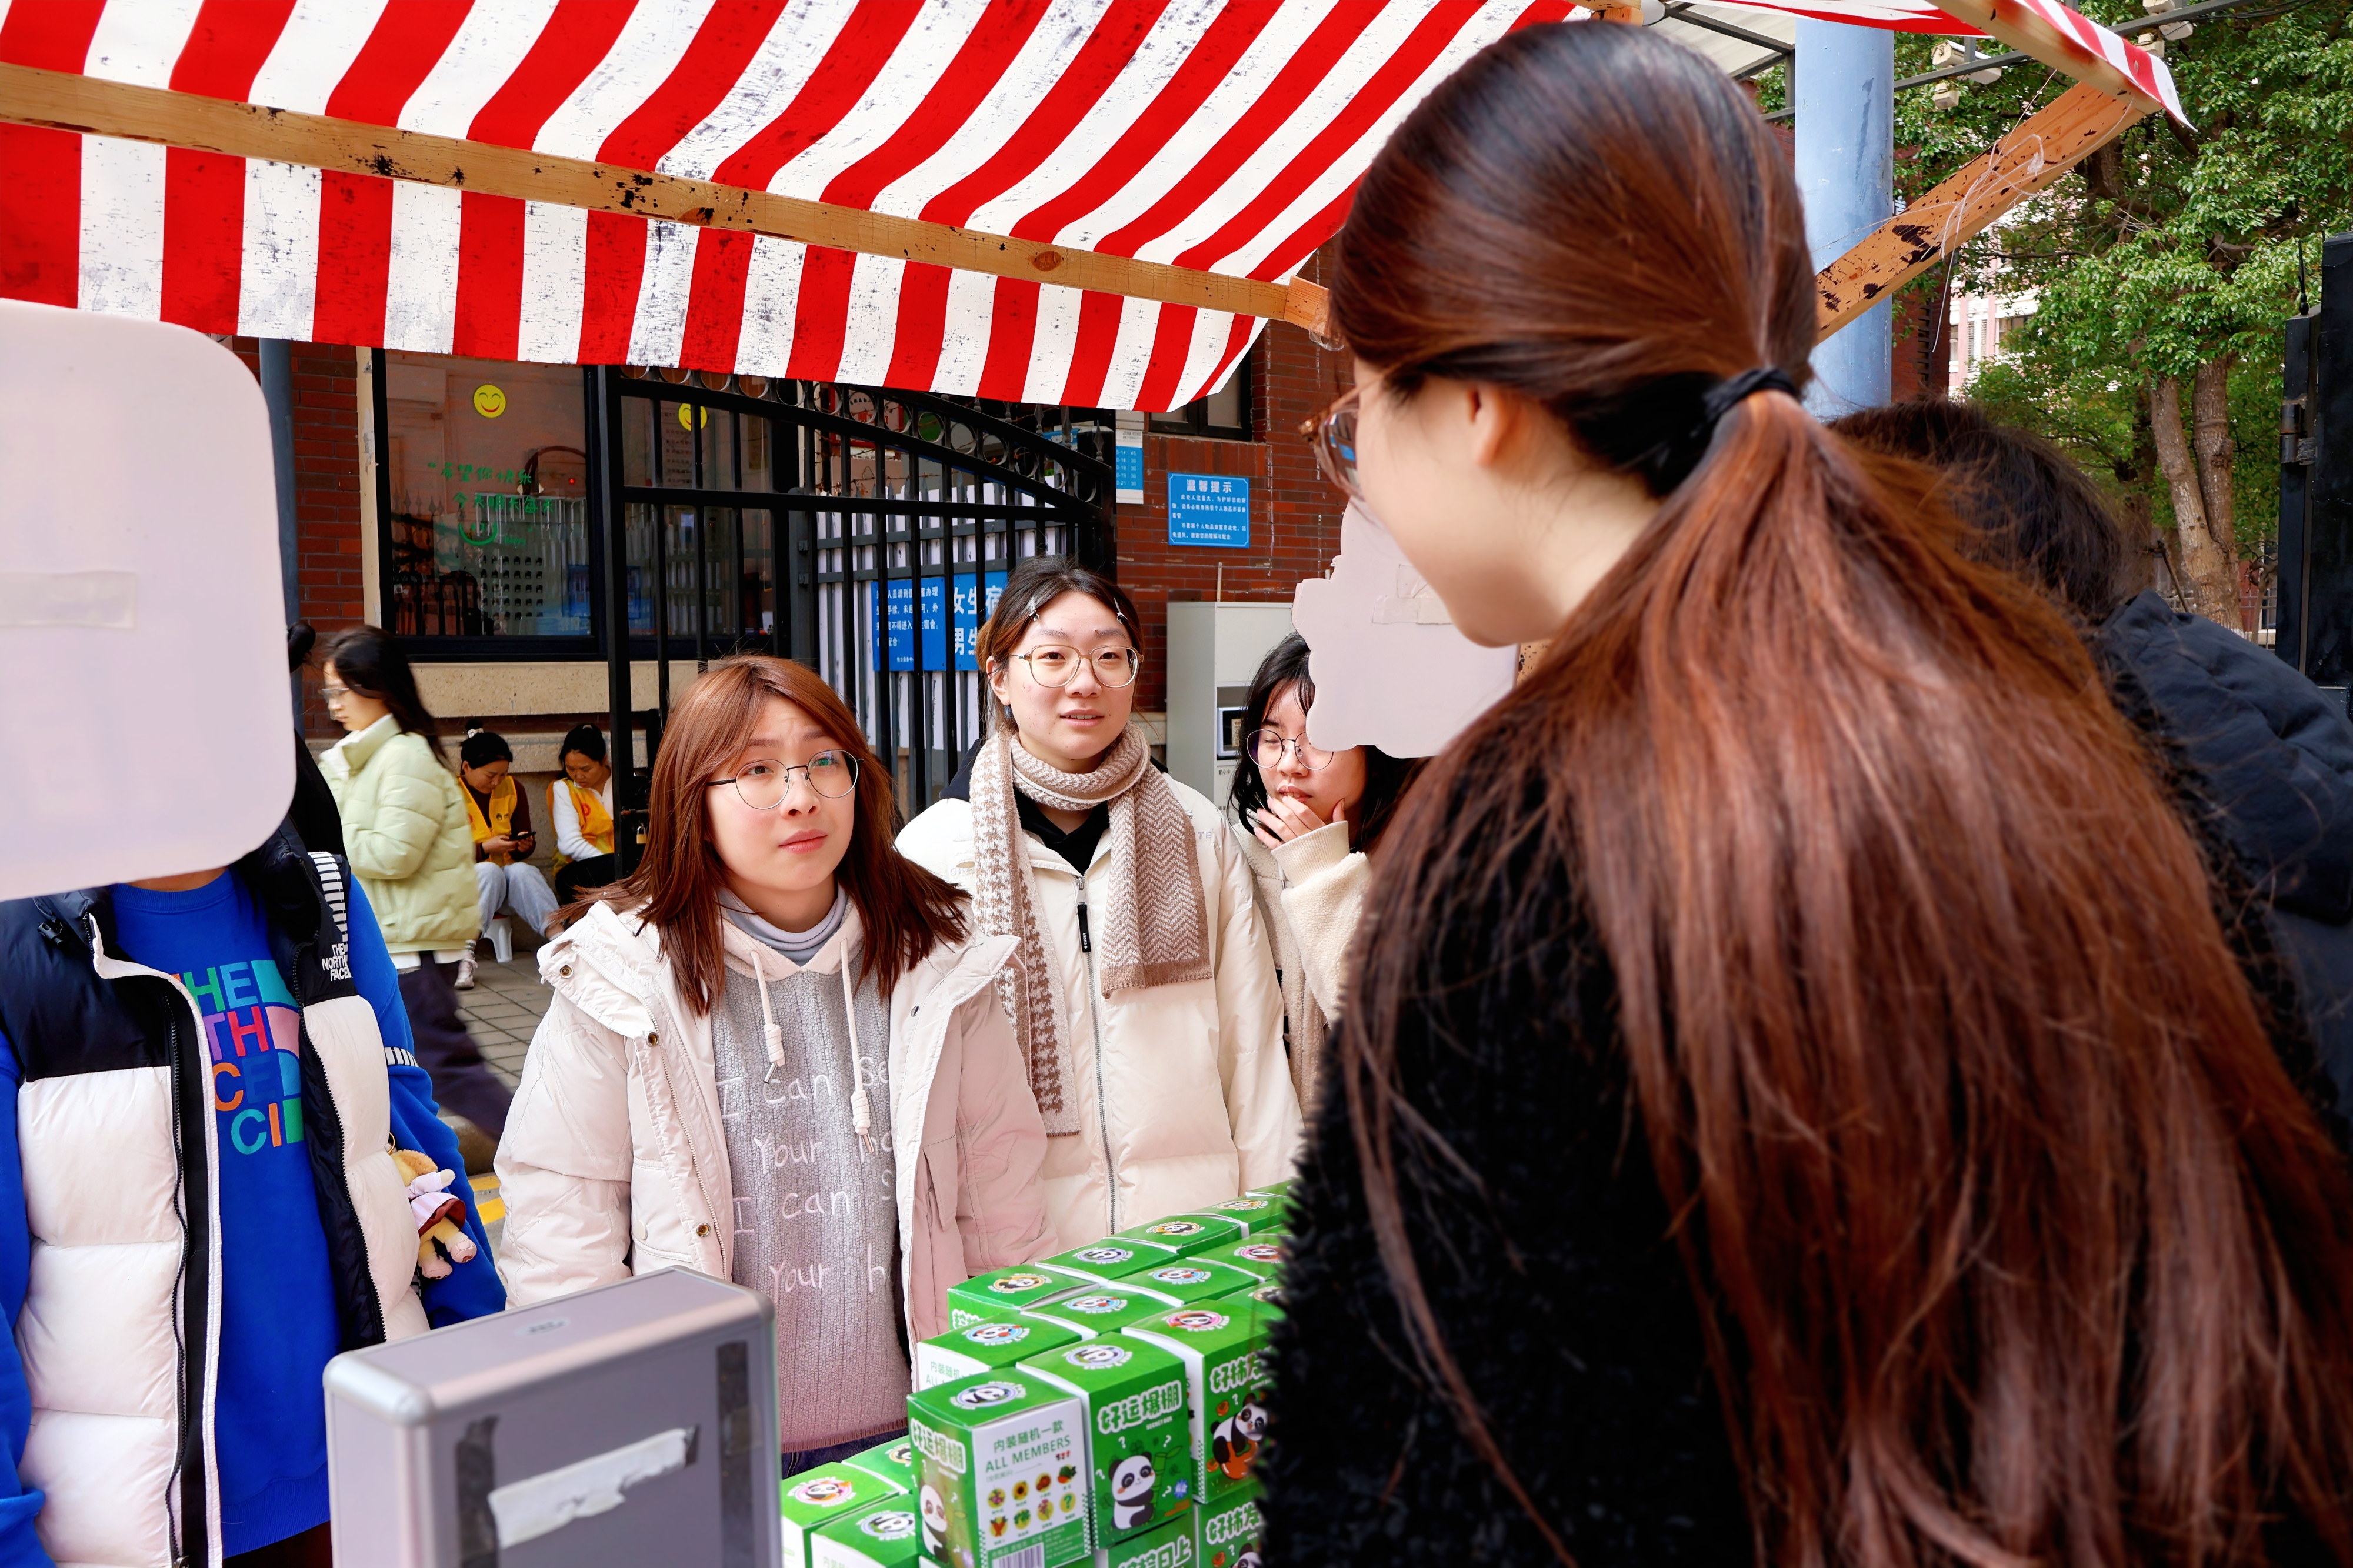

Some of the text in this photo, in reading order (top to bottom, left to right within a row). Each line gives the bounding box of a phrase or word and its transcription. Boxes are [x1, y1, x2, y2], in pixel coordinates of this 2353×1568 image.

[1187, 479, 1232, 493] 温馨提示
[322, 955, 348, 971] NORTH
[332, 943, 345, 956] THE
[171, 962, 258, 1014] HE
[331, 967, 352, 982] FACE
[782, 1190, 851, 1219] can
[1098, 1380, 1182, 1434] 好运爆棚
[994, 1420, 1064, 1453] 内装随机一款
[986, 1434, 1071, 1473] ALL MEMBERS
